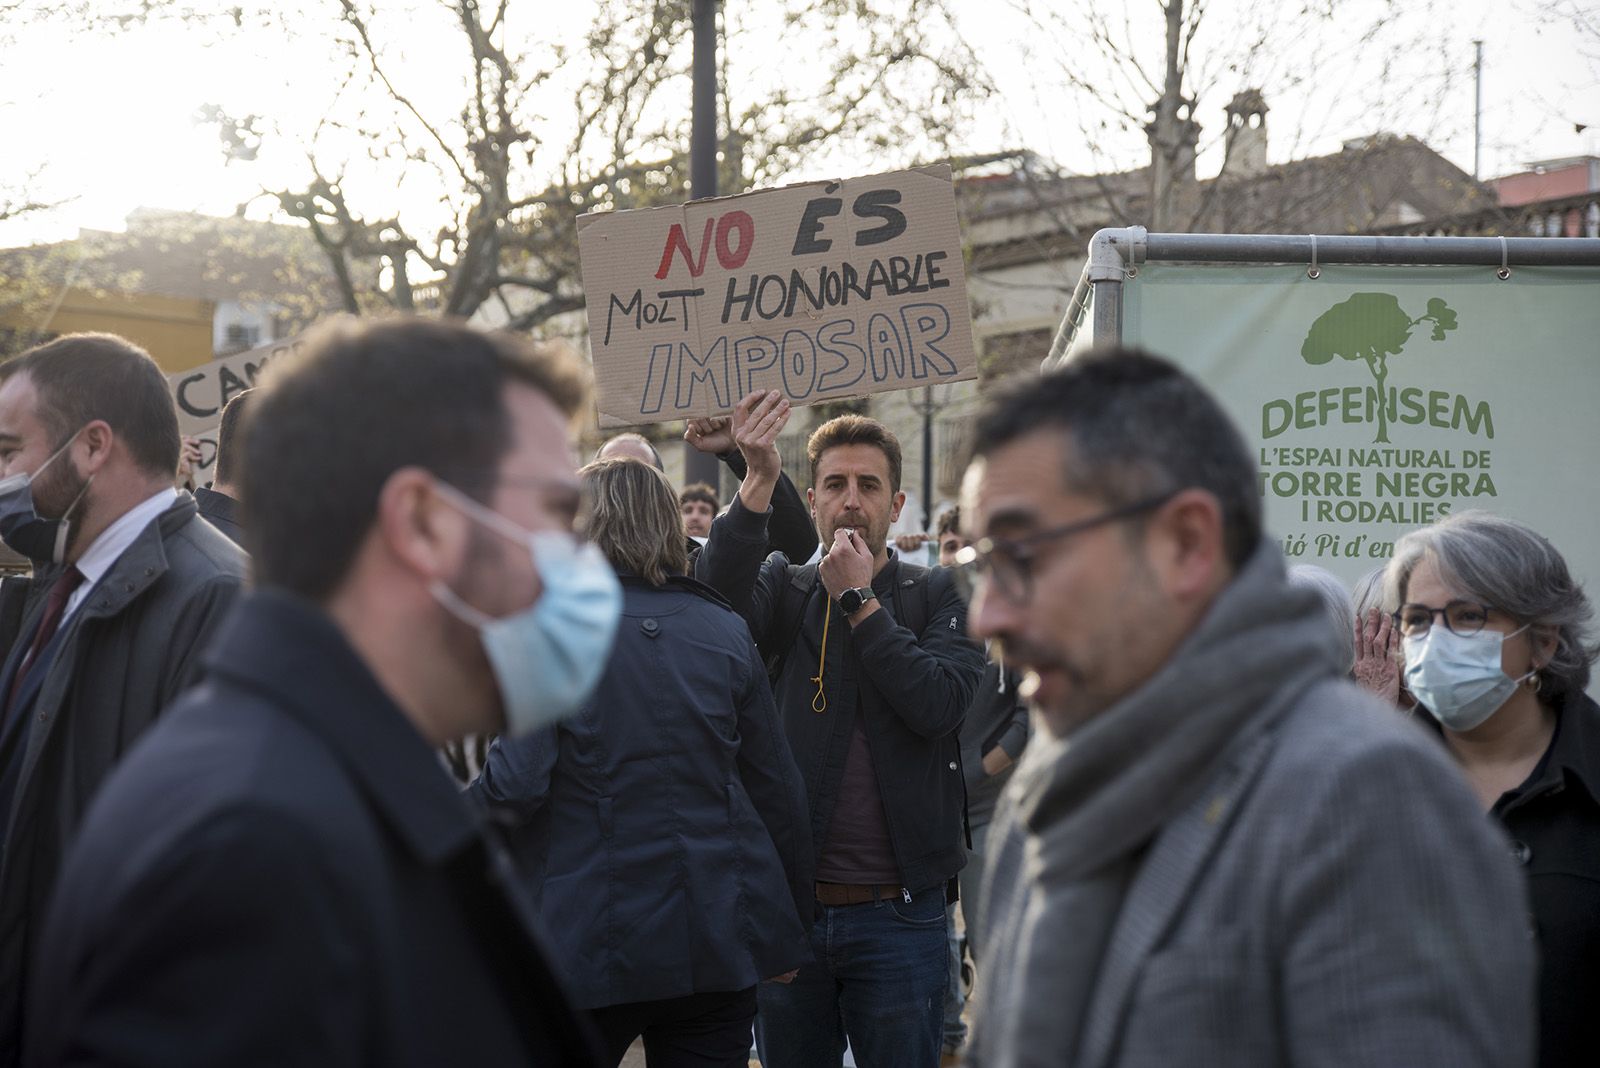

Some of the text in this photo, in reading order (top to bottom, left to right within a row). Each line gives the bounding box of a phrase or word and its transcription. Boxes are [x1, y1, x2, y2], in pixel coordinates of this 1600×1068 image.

[655, 182, 907, 280] NO ÉS
[721, 251, 950, 323] HONORABLE
[640, 303, 957, 414] IMPOSAR
[1262, 386, 1495, 440] DEFENSEM
[1260, 447, 1491, 468] L'ESPAI NATURAL DE
[1376, 472, 1498, 498] NEGRA
[1302, 500, 1452, 525] I RODALIES
[1314, 533, 1341, 557] Pi
